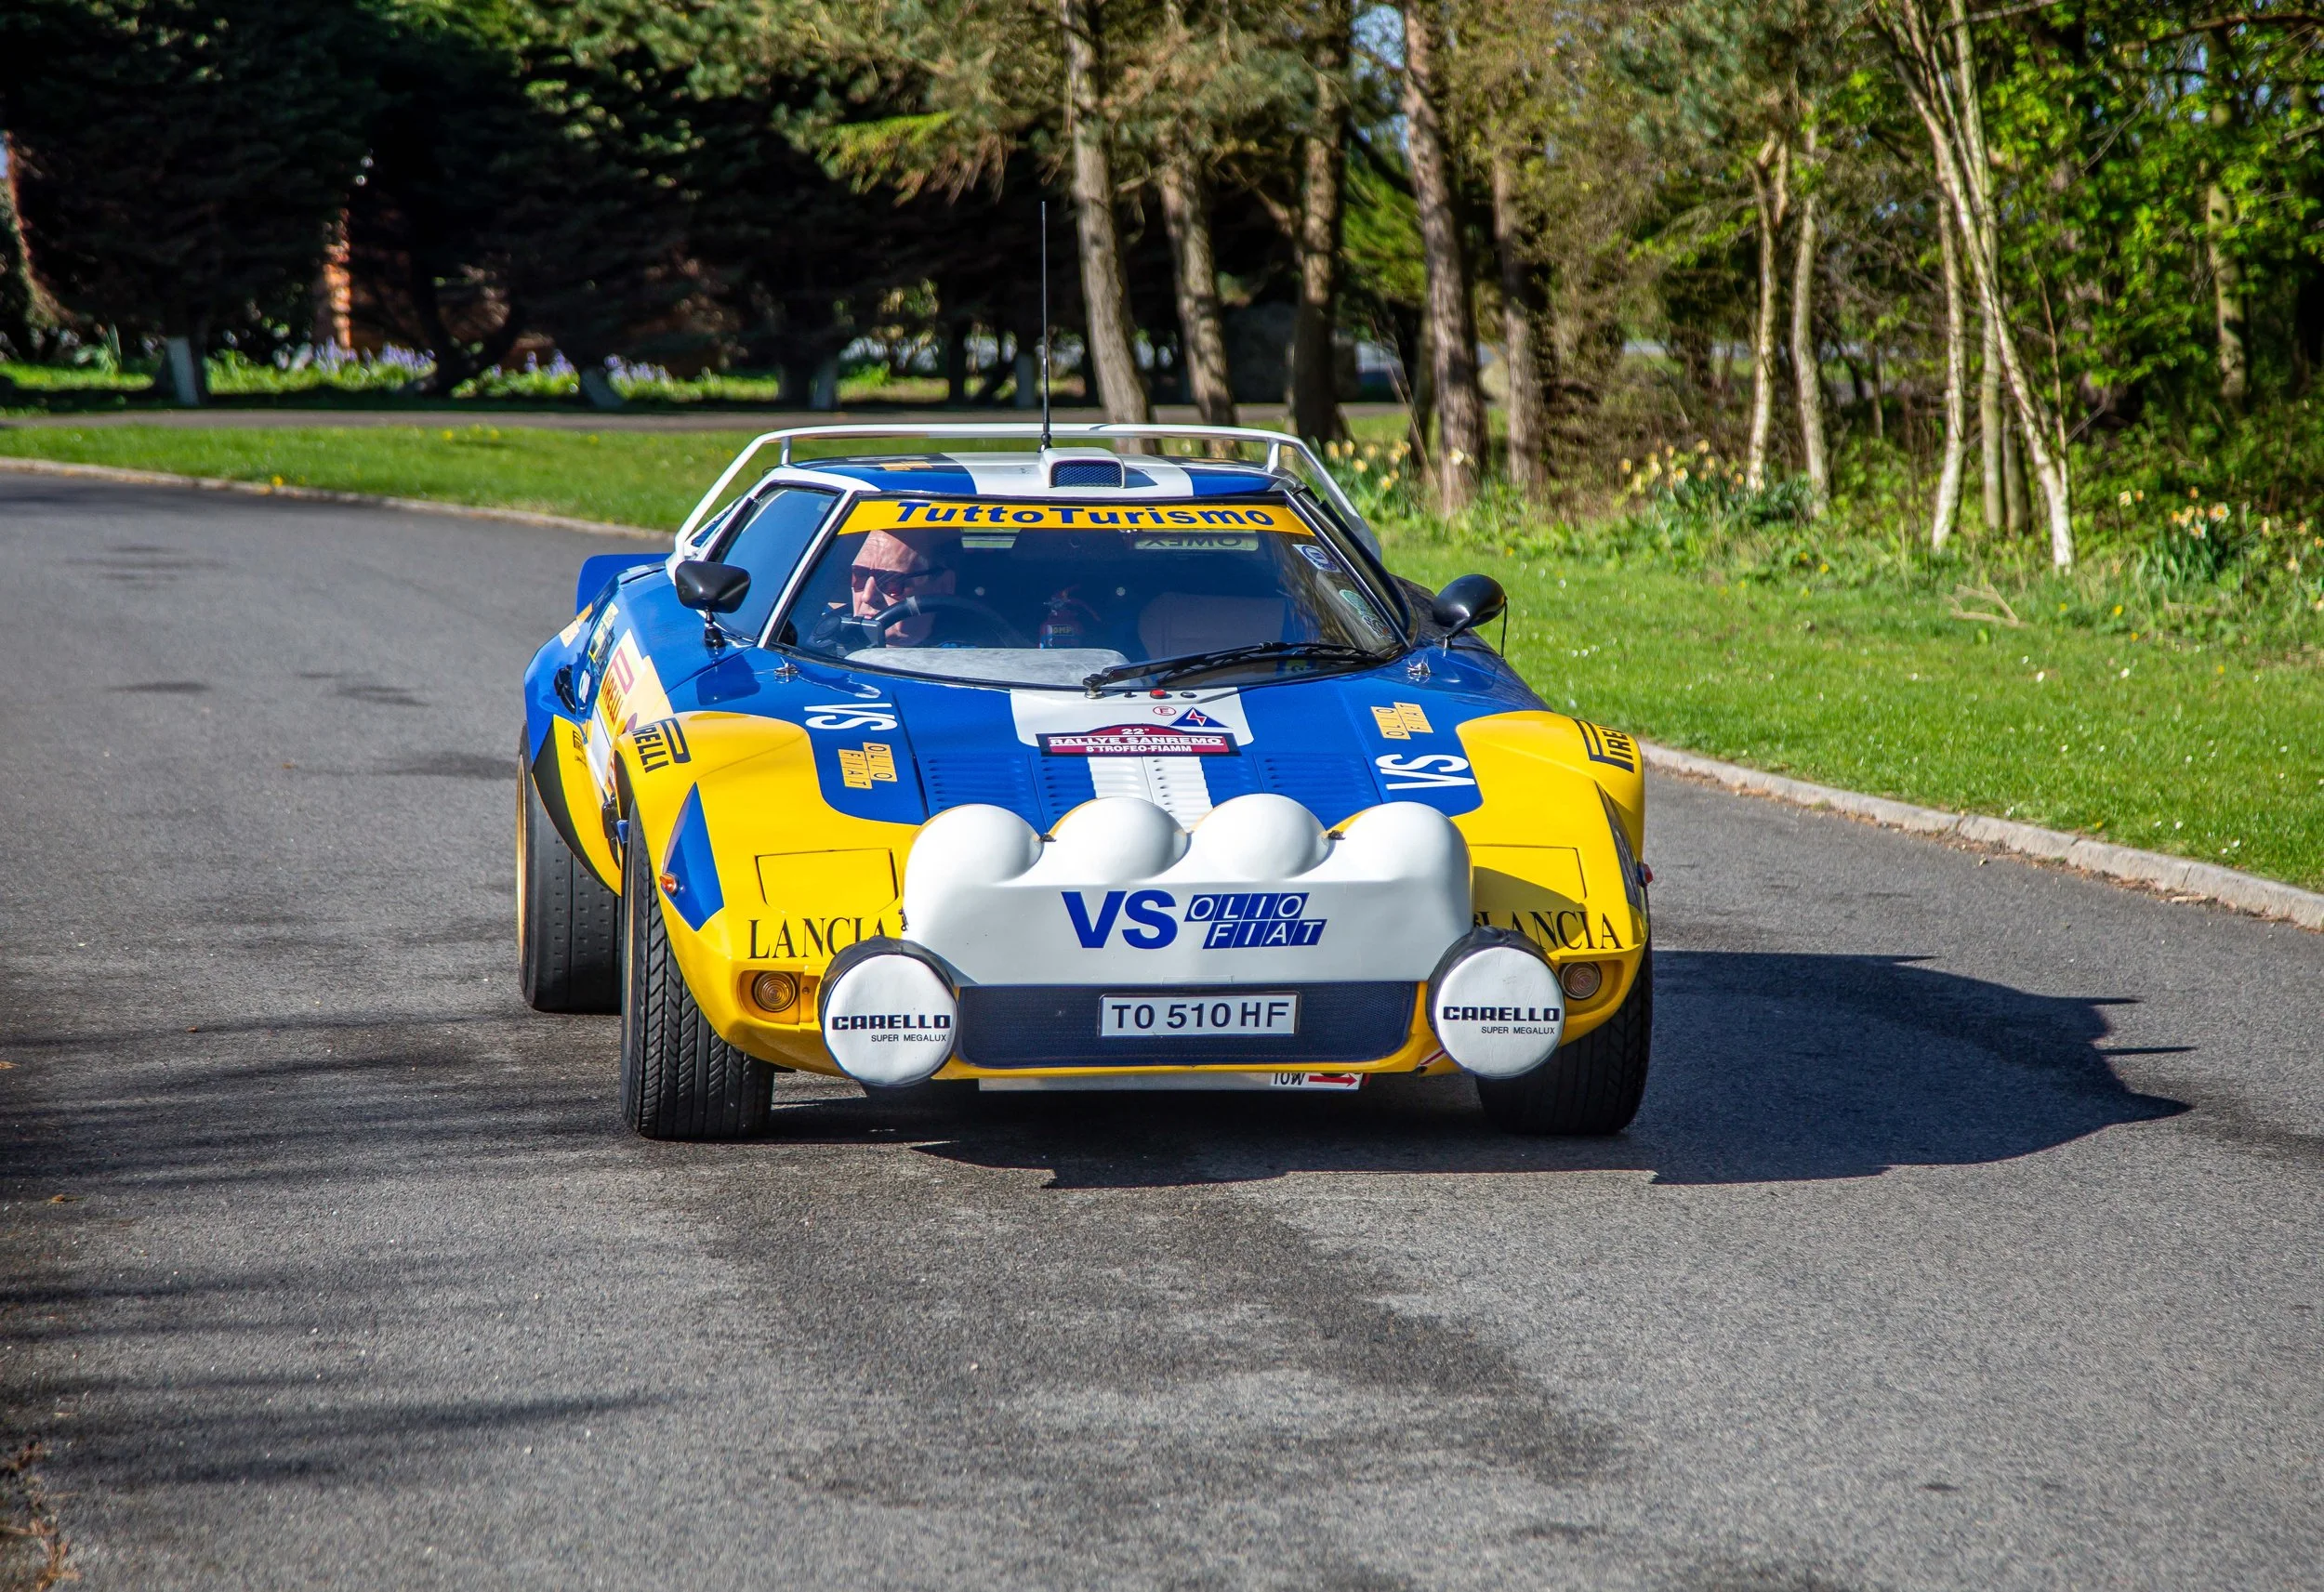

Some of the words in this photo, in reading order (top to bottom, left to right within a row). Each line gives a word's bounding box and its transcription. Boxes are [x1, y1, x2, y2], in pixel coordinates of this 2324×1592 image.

[896, 502, 1274, 527] TuttoTurismo
[804, 703, 898, 730] VS
[1050, 737, 1127, 745] RALLYE
[843, 752, 866, 786] FIAT
[867, 745, 893, 779] OLIO
[1376, 754, 1475, 790] VS
[1061, 889, 1178, 949] VS
[1190, 894, 1301, 920] OLIO
[1210, 921, 1323, 946] FIAT
[832, 1015, 951, 1031] CARELLO
[1167, 1003, 1232, 1029] 510
[1241, 1002, 1289, 1028] HF
[1443, 1006, 1560, 1021] CARELLO
[871, 1033, 899, 1043] SUPER
[904, 1033, 946, 1042] MEGALUX
[1481, 1026, 1509, 1034] SUPER
[1513, 1026, 1555, 1034] MEGALUX
